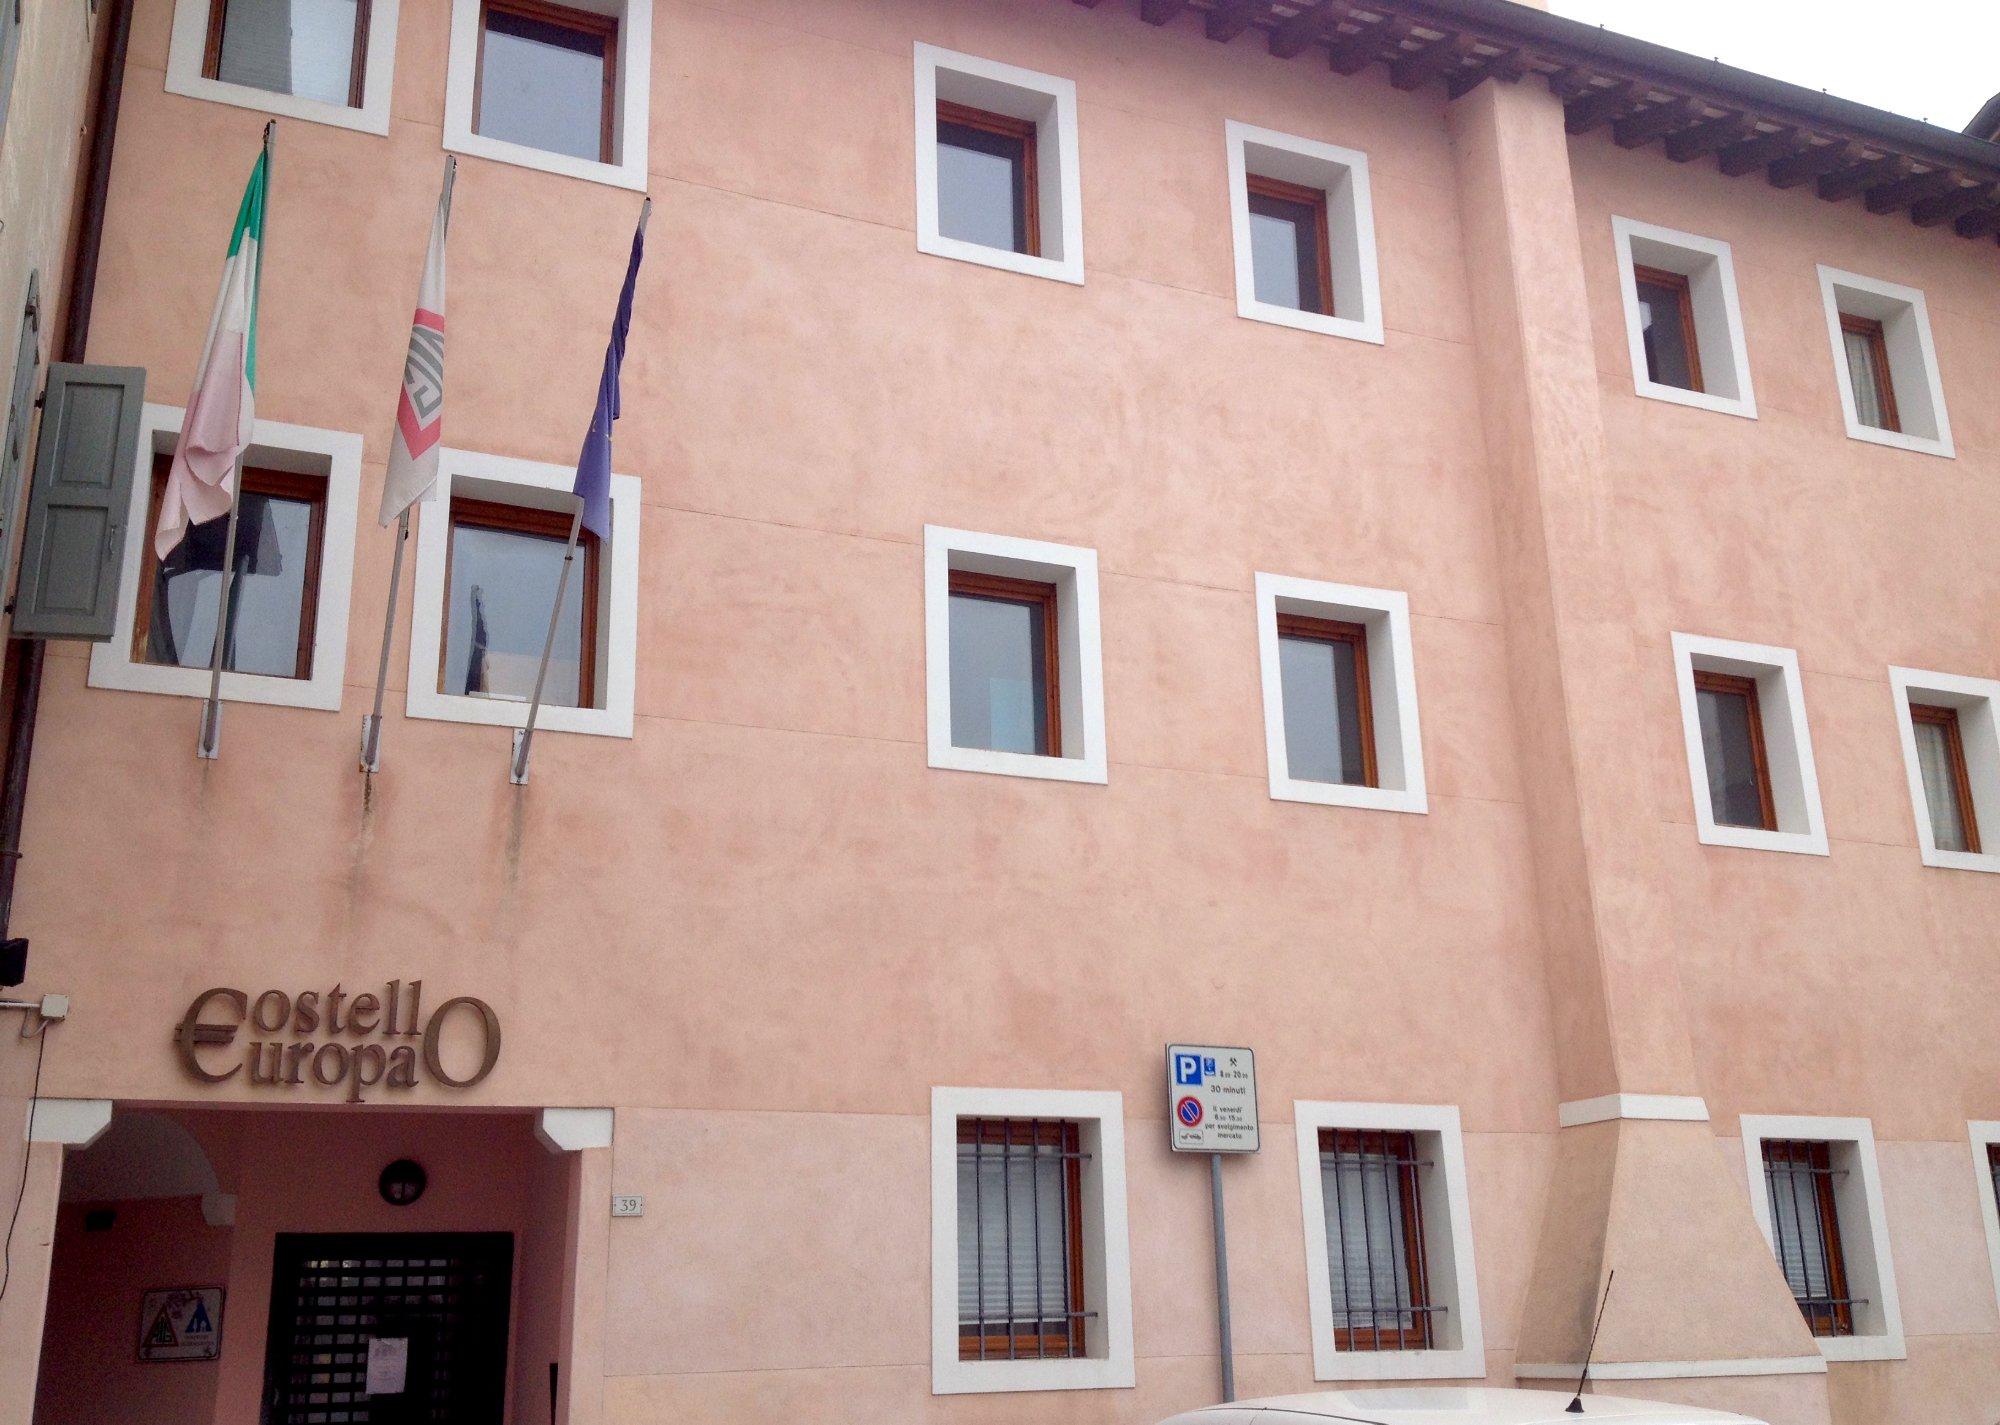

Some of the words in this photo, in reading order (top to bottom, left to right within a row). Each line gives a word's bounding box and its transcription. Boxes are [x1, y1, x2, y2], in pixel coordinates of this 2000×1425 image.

[1180, 1057, 1197, 1084] P
[1210, 1085, 1221, 1093] 30
[1223, 1086, 1246, 1095] minuti
[619, 1199, 636, 1212] 39
